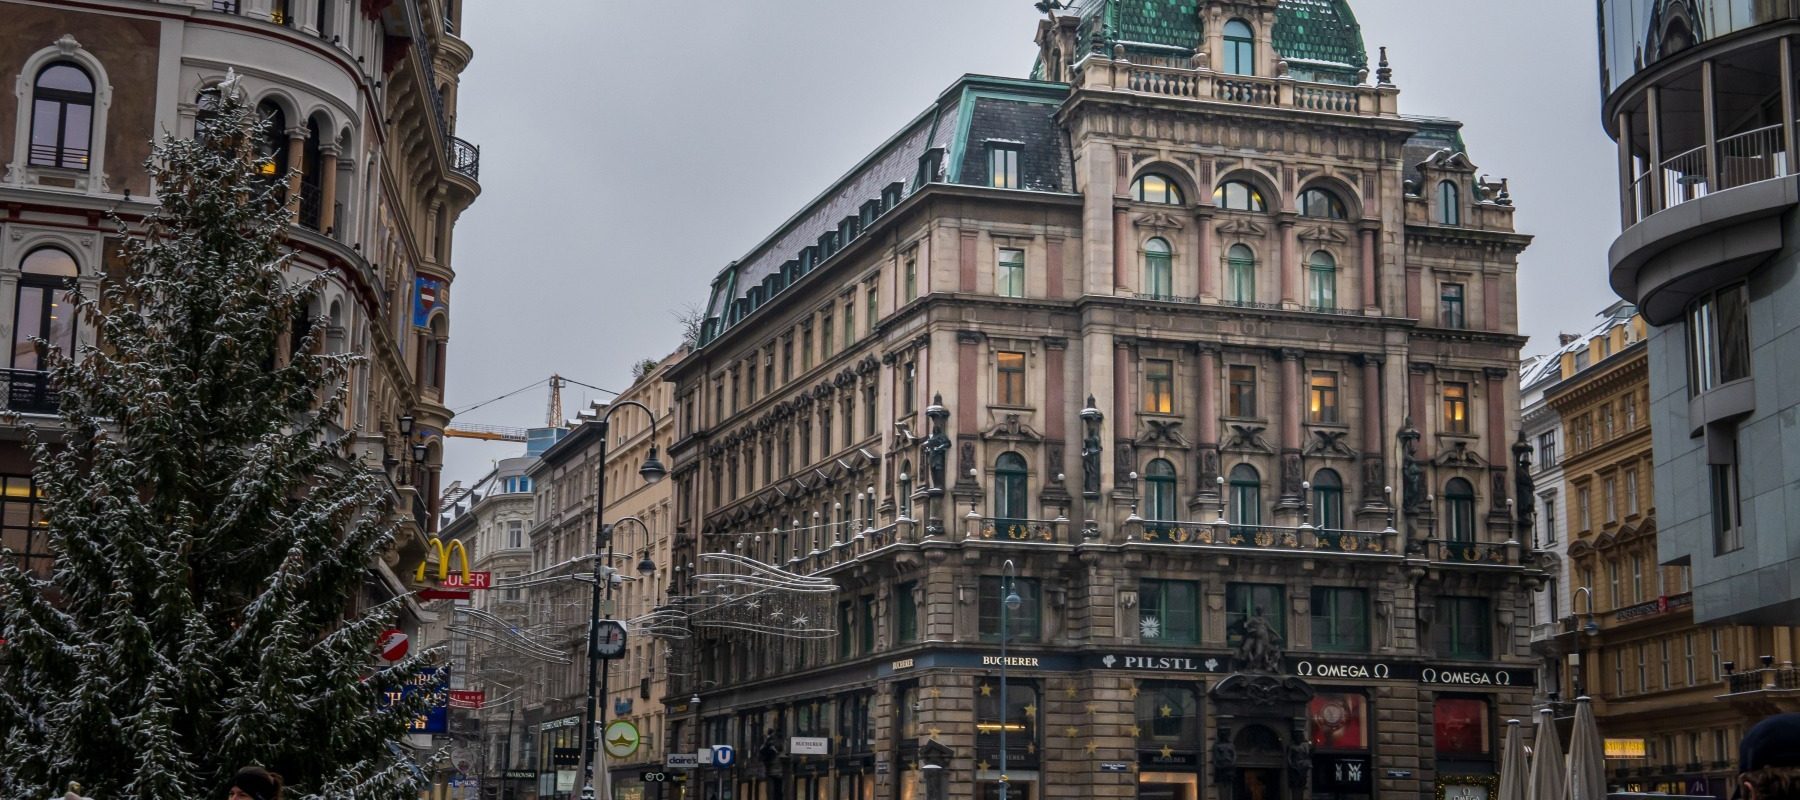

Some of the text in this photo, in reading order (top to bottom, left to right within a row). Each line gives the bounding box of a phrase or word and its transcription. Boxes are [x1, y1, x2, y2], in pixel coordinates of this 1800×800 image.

[983, 656, 1039, 667] BUCHERER
[1125, 656, 1197, 670] PILSTL
[1317, 664, 1369, 678] OMEGA
[1441, 671, 1491, 684] OMEGA
[718, 749, 731, 764] U
